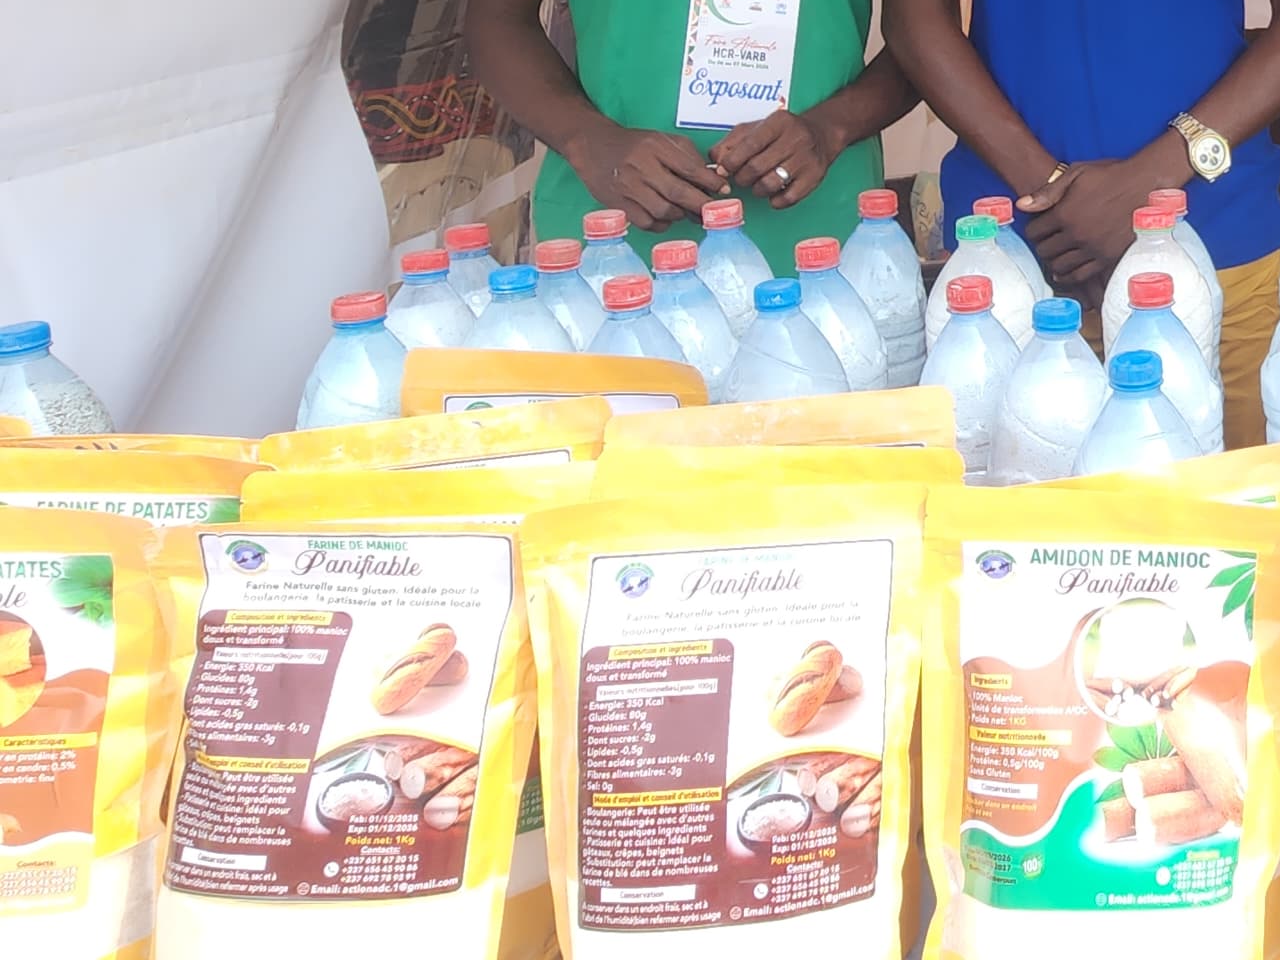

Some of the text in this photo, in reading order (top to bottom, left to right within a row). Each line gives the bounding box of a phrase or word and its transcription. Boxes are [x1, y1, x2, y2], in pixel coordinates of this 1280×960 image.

[713, 47, 766, 62] HCR-VARB
[688, 67, 783, 107] Exposant
[132, 502, 208, 519] PATATES
[308, 540, 409, 551] FARINE DE MANIOC
[291, 549, 422, 580] Panifiable
[1030, 548, 1210, 569] AMIDON DE MANIOC
[1055, 567, 1180, 598] Panifiable
[674, 656, 698, 665] 100%
[700, 655, 731, 664] manioc
[608, 673, 618, 681] et
[626, 699, 643, 708] 350
[645, 697, 664, 706] Kcal
[345, 836, 372, 845] Poids
[396, 836, 415, 845] 1Kg
